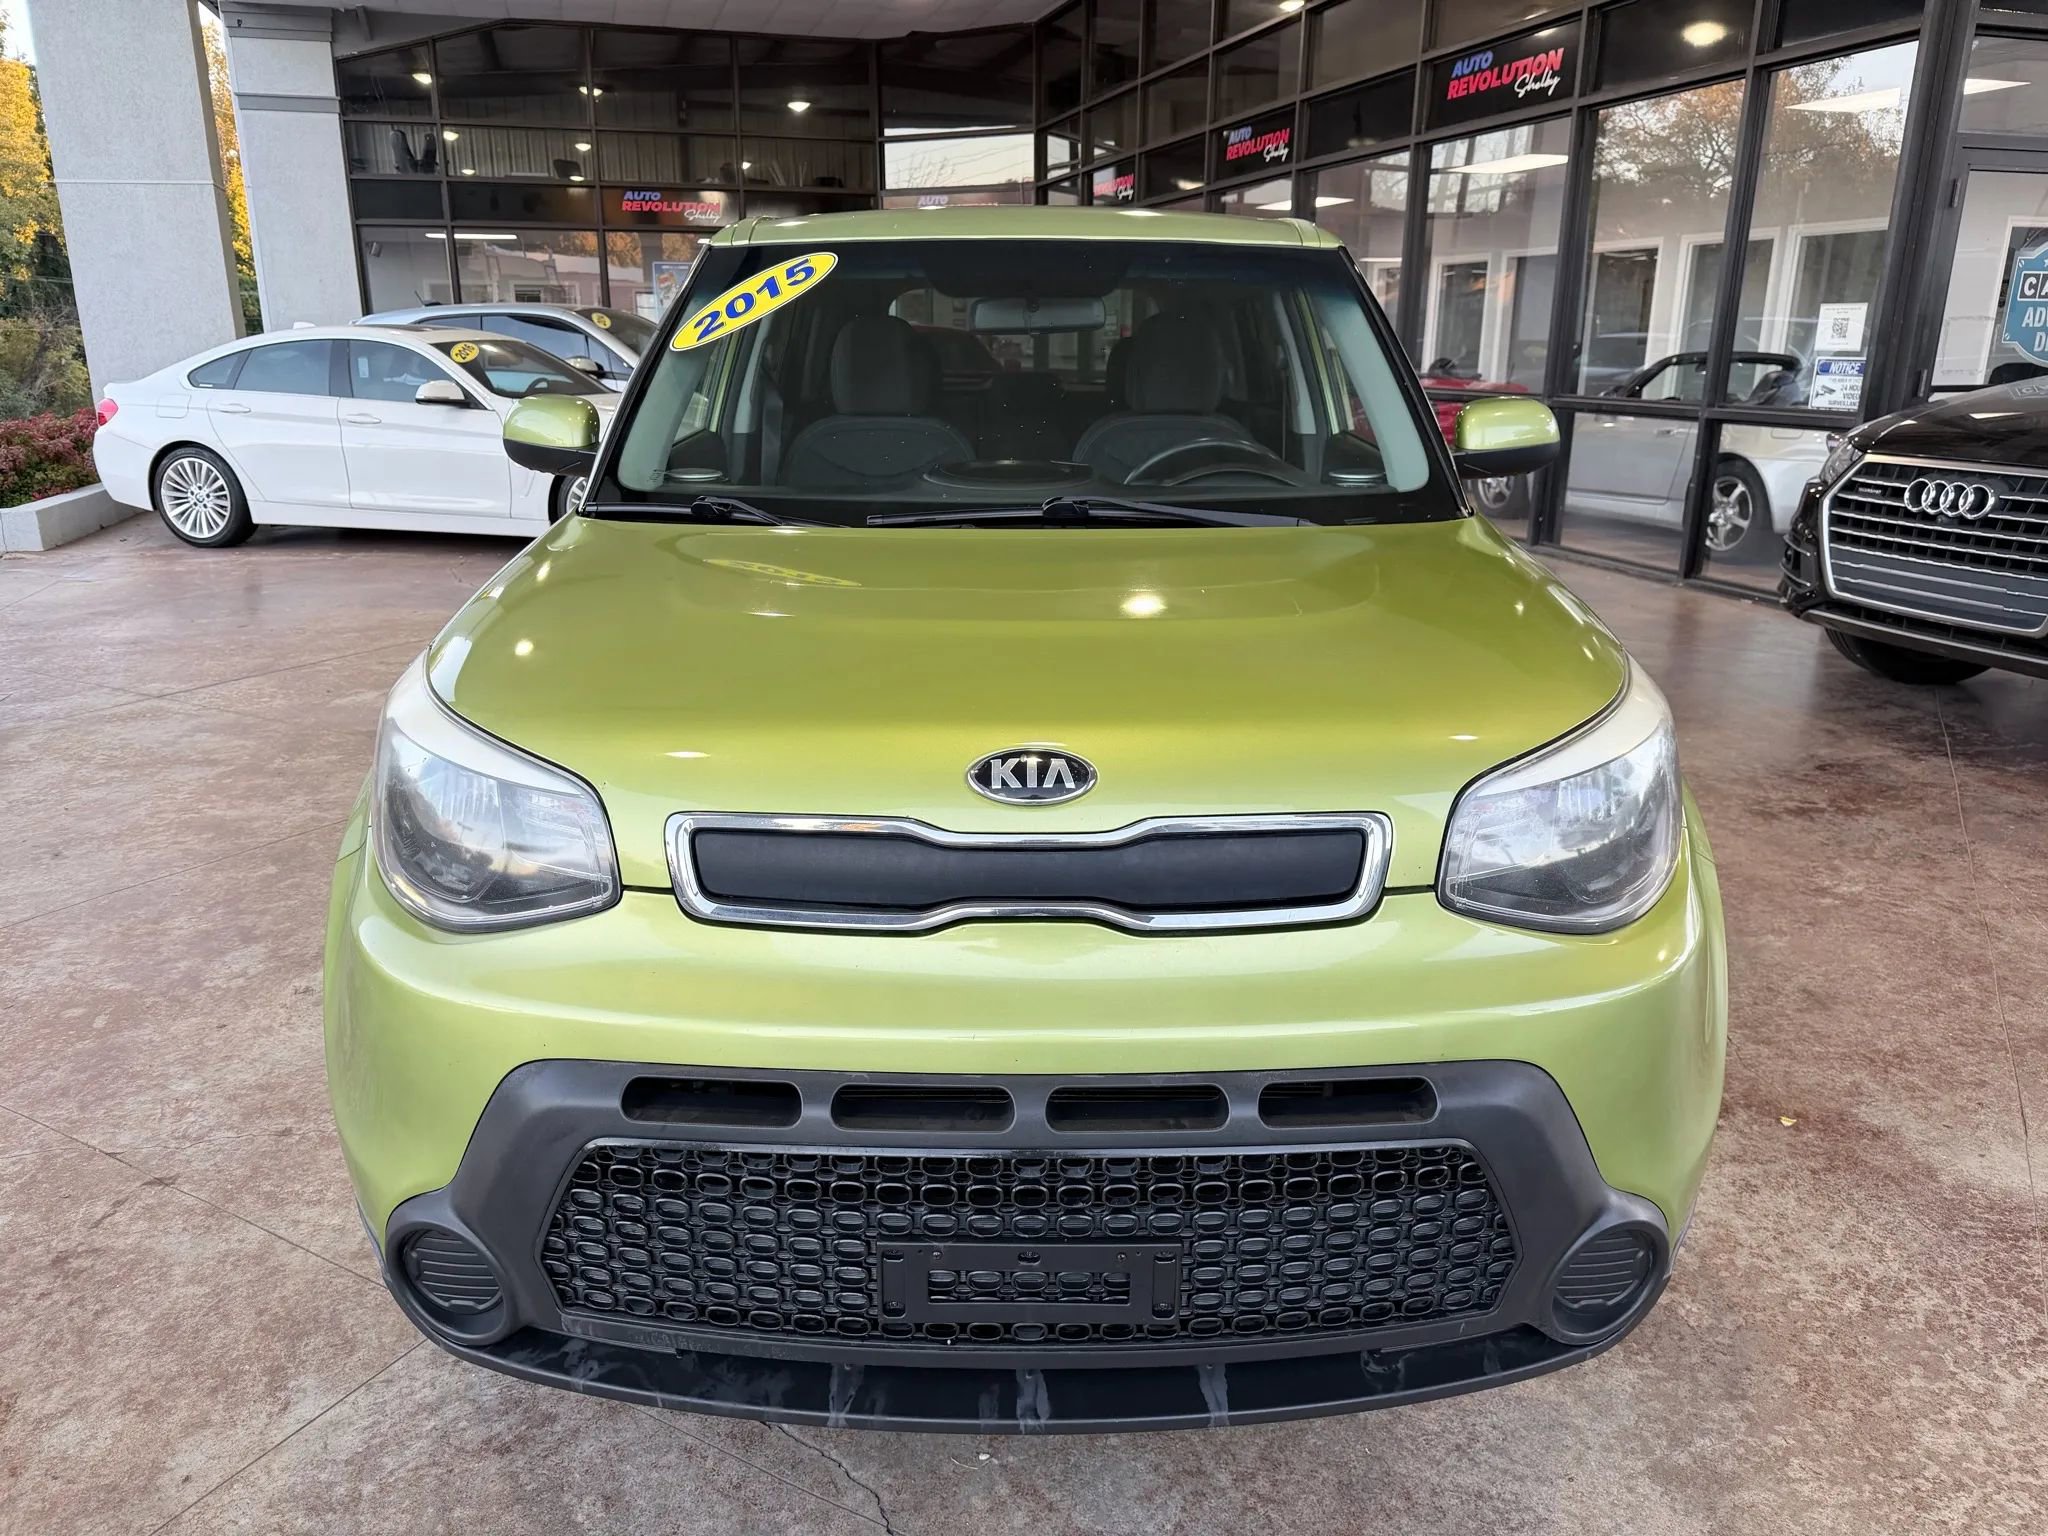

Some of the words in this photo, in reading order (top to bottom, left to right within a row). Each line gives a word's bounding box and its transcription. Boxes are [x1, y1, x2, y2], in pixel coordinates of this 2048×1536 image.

[1447, 47, 1564, 100] REVOLUTION
[1451, 50, 1494, 78] AUTO
[1514, 66, 1560, 98] Shelby
[1226, 127, 1290, 161] REVOLUTION
[1228, 125, 1252, 145] AUTO
[622, 201, 721, 212] REVOLUTION
[623, 191, 661, 201] AUTO
[917, 195, 949, 205] AUTO
[684, 209, 721, 223] Shelby
[693, 257, 817, 342] 2015
[1829, 361, 1862, 375] NOTICE
[990, 758, 1076, 789] KIA
